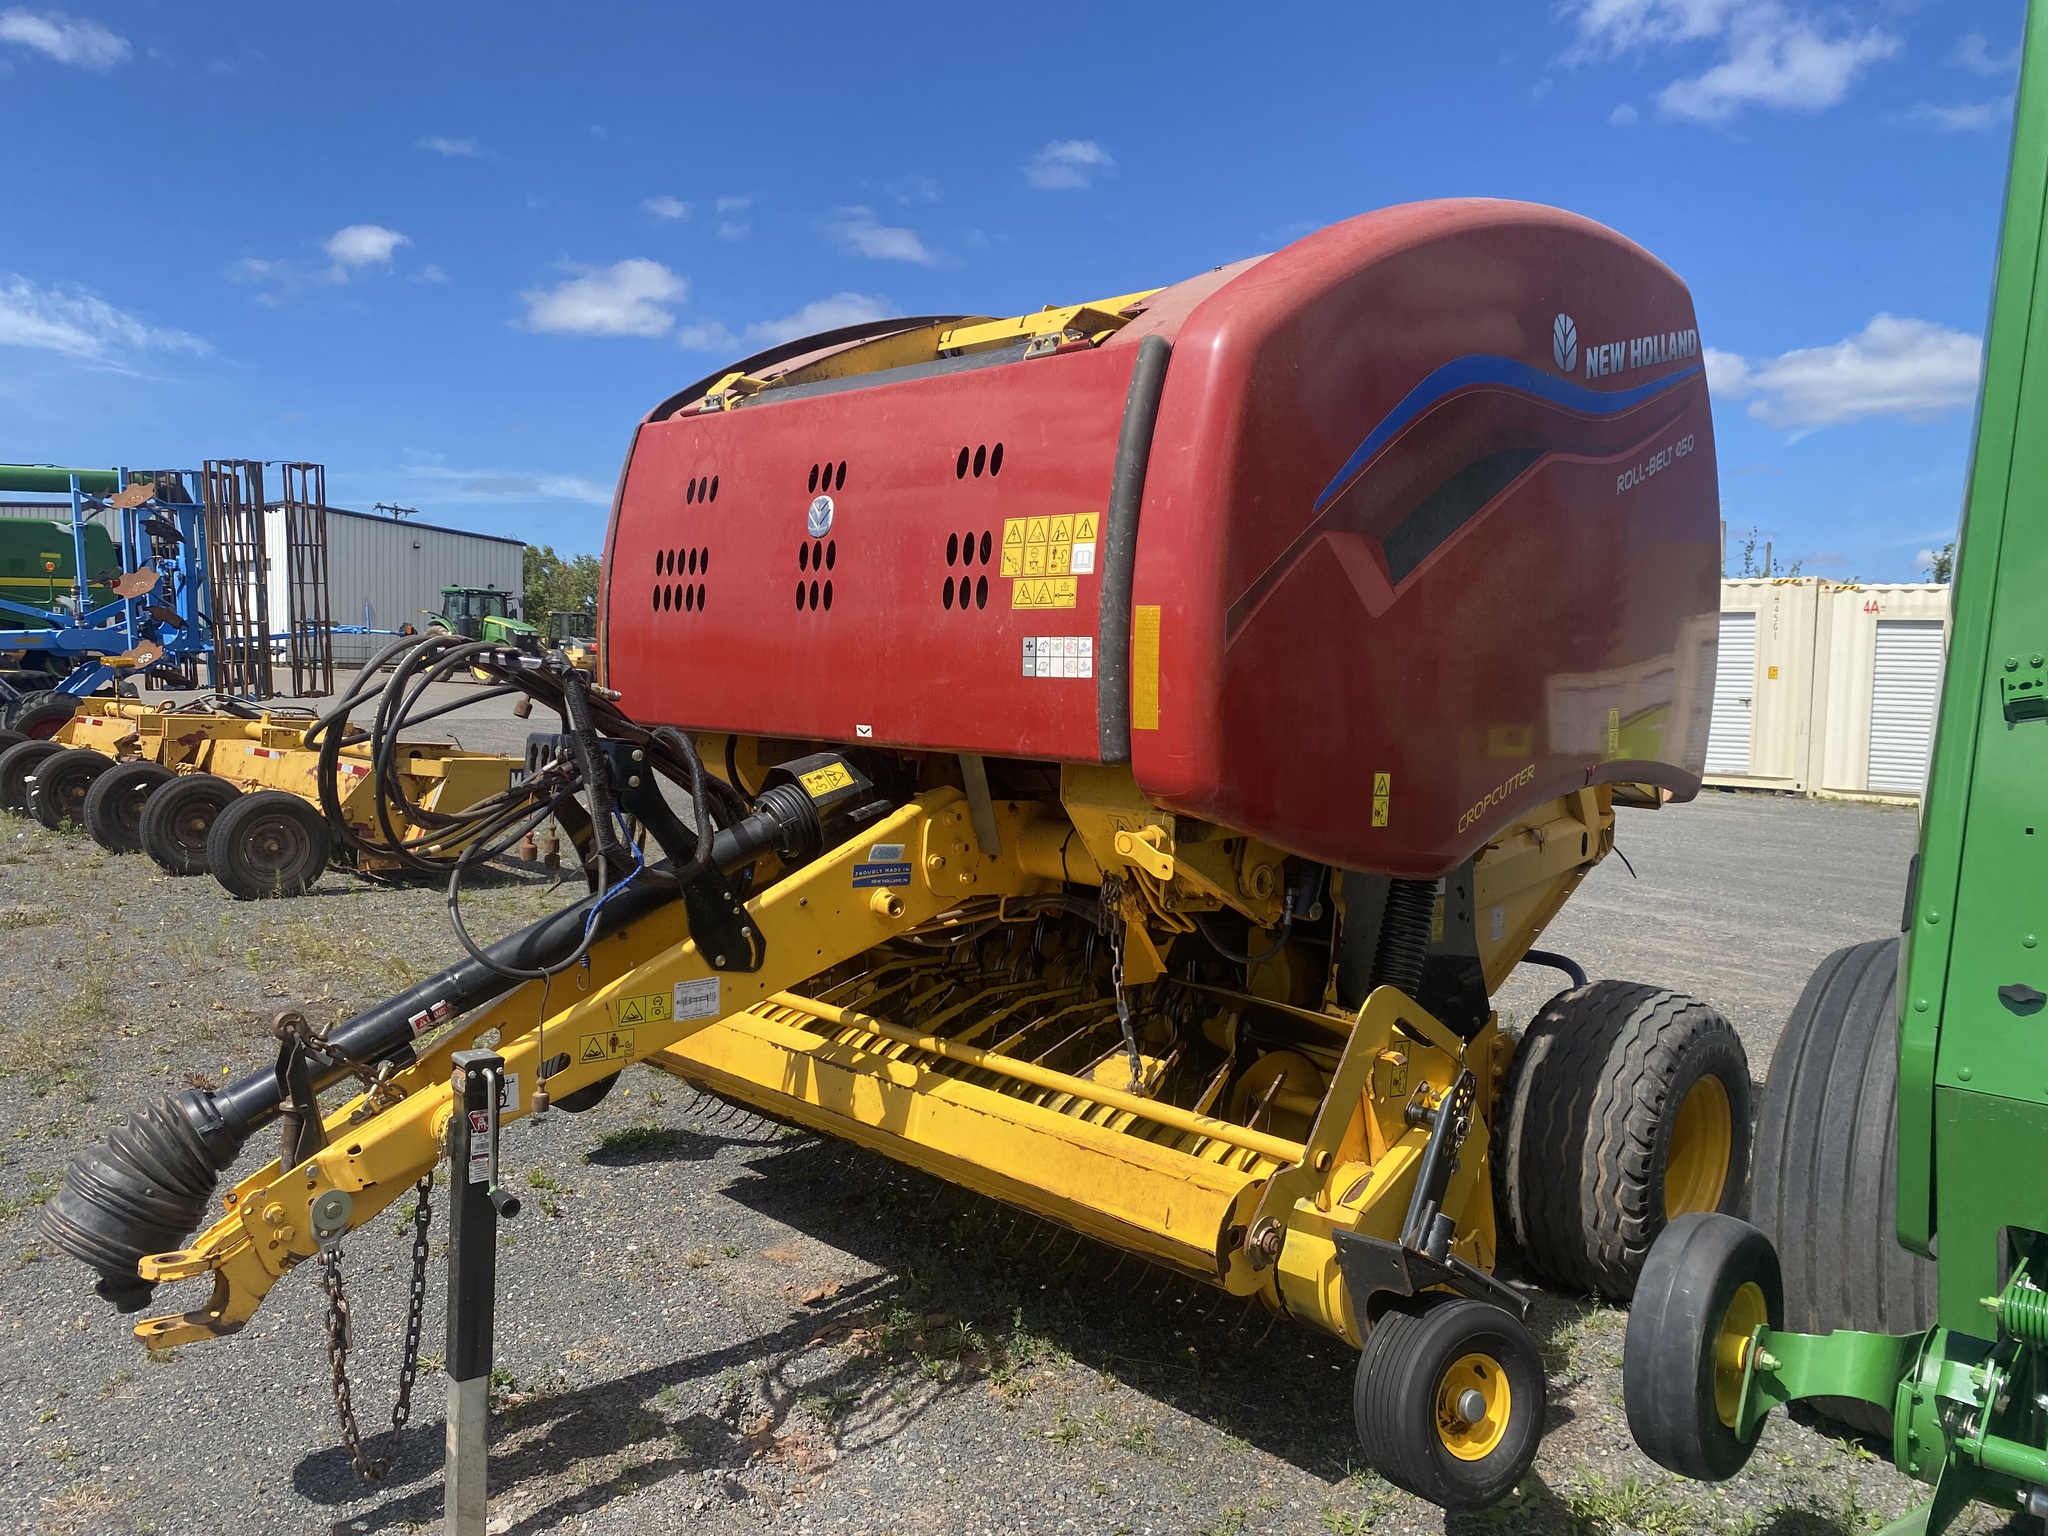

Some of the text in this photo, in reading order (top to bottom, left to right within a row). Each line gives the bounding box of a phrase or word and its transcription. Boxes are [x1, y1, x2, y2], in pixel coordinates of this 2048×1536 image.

[1586, 329, 1697, 379] NEW HOLLAND
[1616, 434, 1694, 495] ROLL-BELT 450
[1863, 600, 1879, 614] 4A
[1458, 764, 1535, 834] CROPCUTTER
